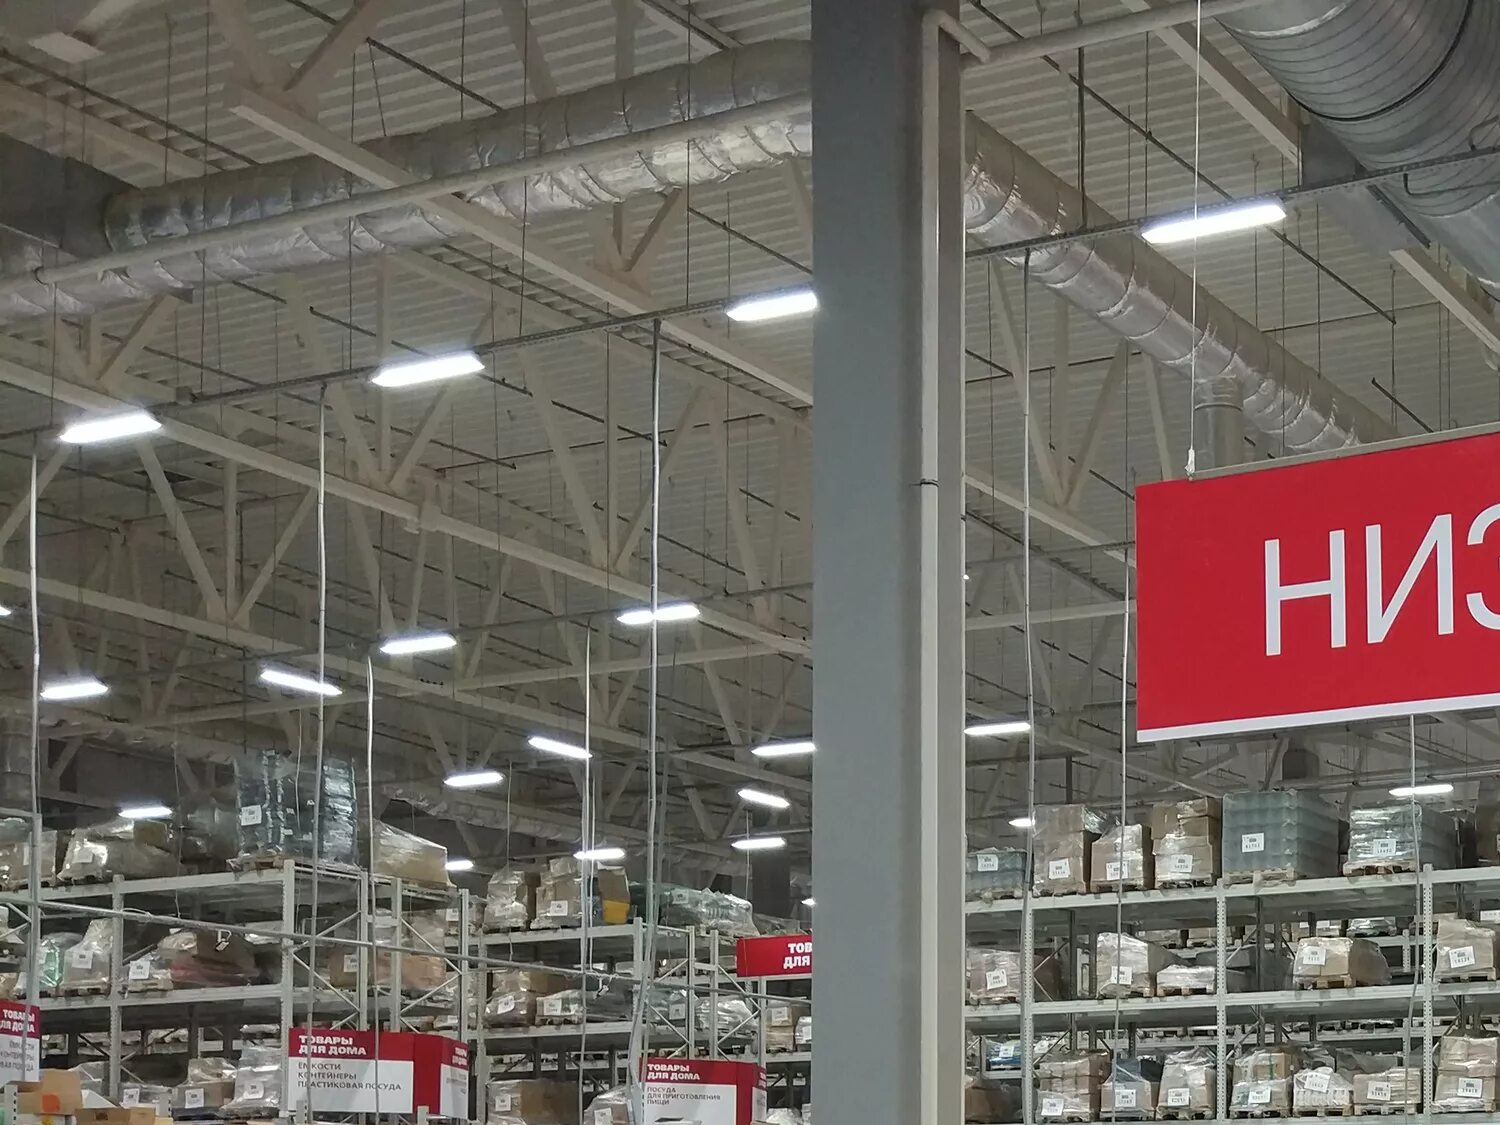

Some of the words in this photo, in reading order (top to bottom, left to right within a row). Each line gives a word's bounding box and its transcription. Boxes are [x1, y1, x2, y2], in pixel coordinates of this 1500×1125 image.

[788, 942, 813, 954] ТОВ
[784, 955, 810, 969] ДЛЯ
[299, 1035, 353, 1046] ТОВАРЫ
[299, 1045, 326, 1054] ДЛЯ
[328, 1046, 367, 1056] ДОМА
[647, 1063, 690, 1072] ТОВАРЫ
[647, 1072, 669, 1080] ДЛЯ
[670, 1072, 701, 1081] ДОМА
